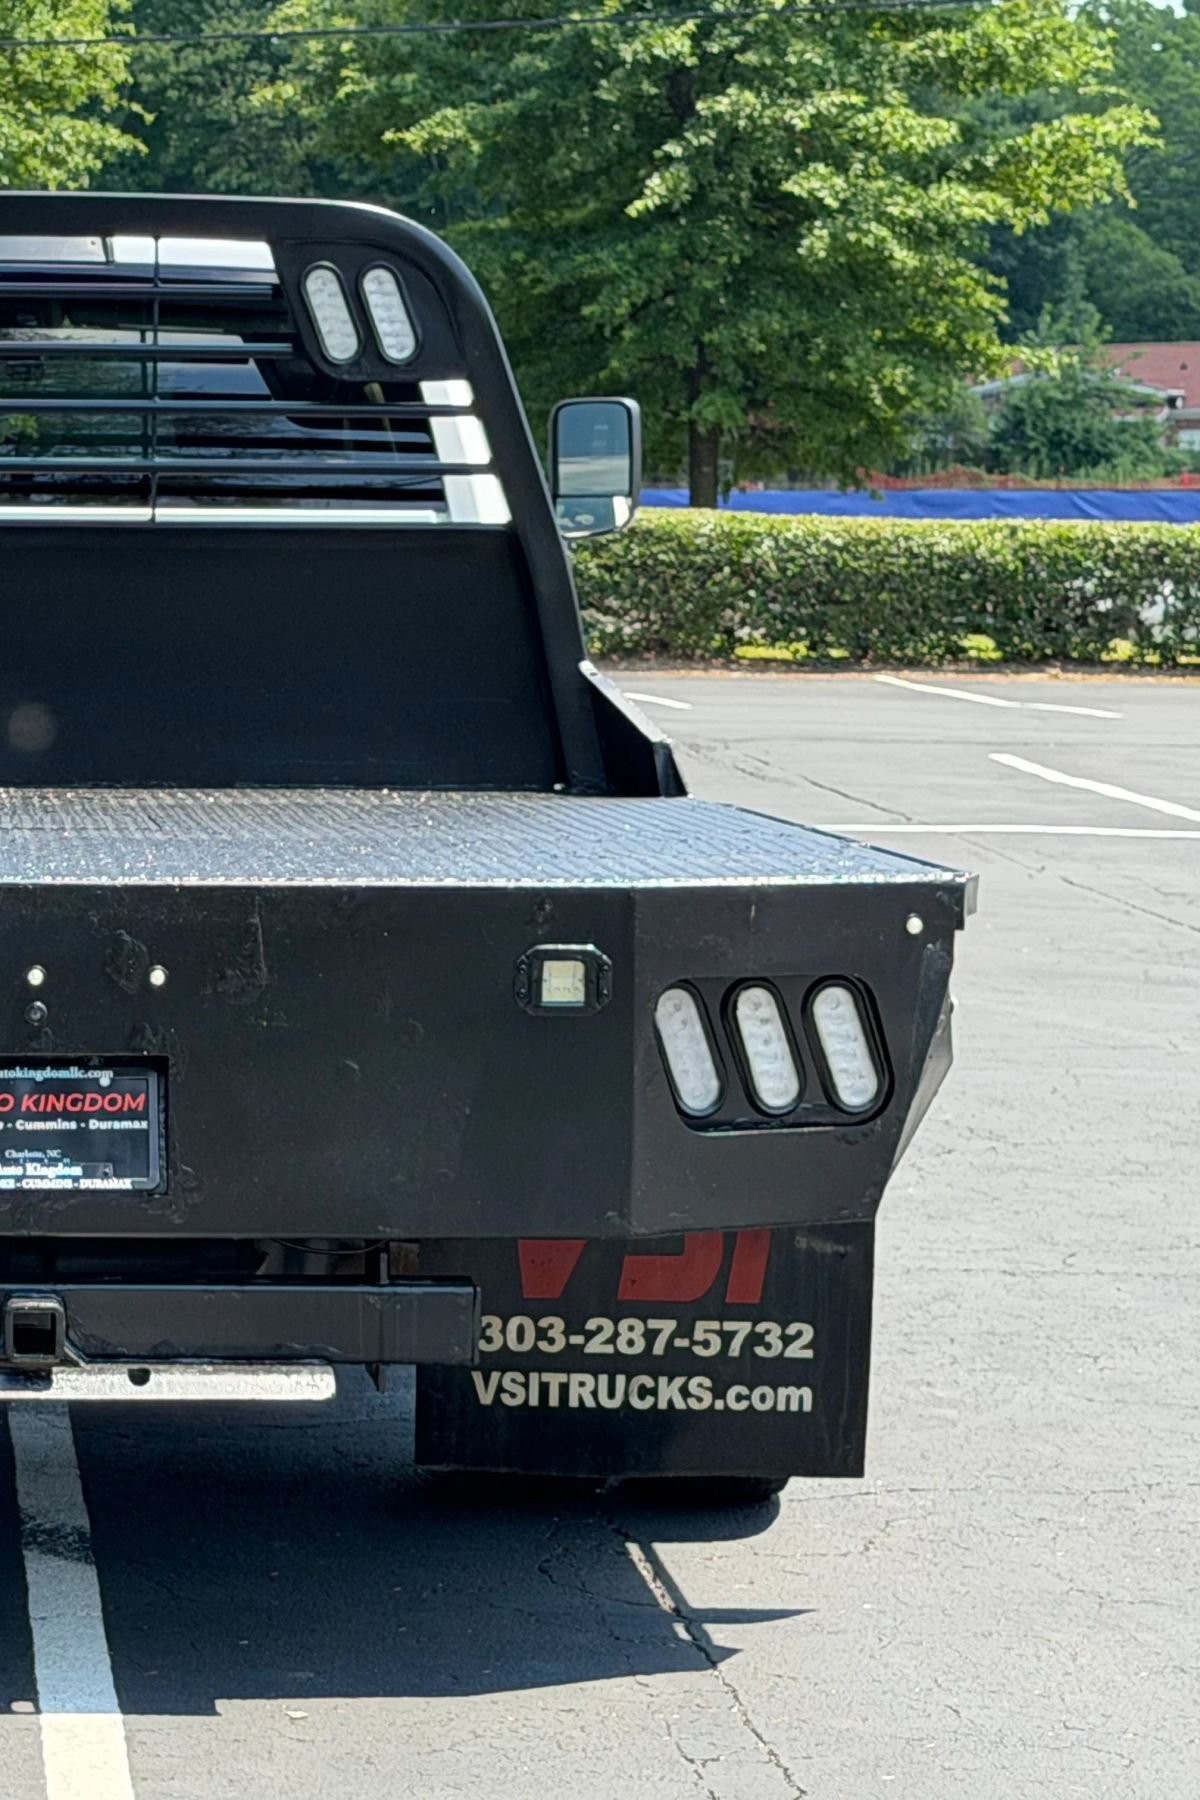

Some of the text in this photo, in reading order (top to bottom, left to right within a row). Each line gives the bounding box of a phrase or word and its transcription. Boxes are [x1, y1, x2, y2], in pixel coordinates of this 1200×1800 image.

[20, 1092, 145, 1112] KINGDOM
[15, 1118, 77, 1131] Cummins
[89, 1118, 148, 1130] Duramax
[26, 1162, 83, 1179] Kingdom
[478, 1315, 814, 1359] 303-287-5732
[471, 1371, 813, 1413] VSITRUCKS.com
